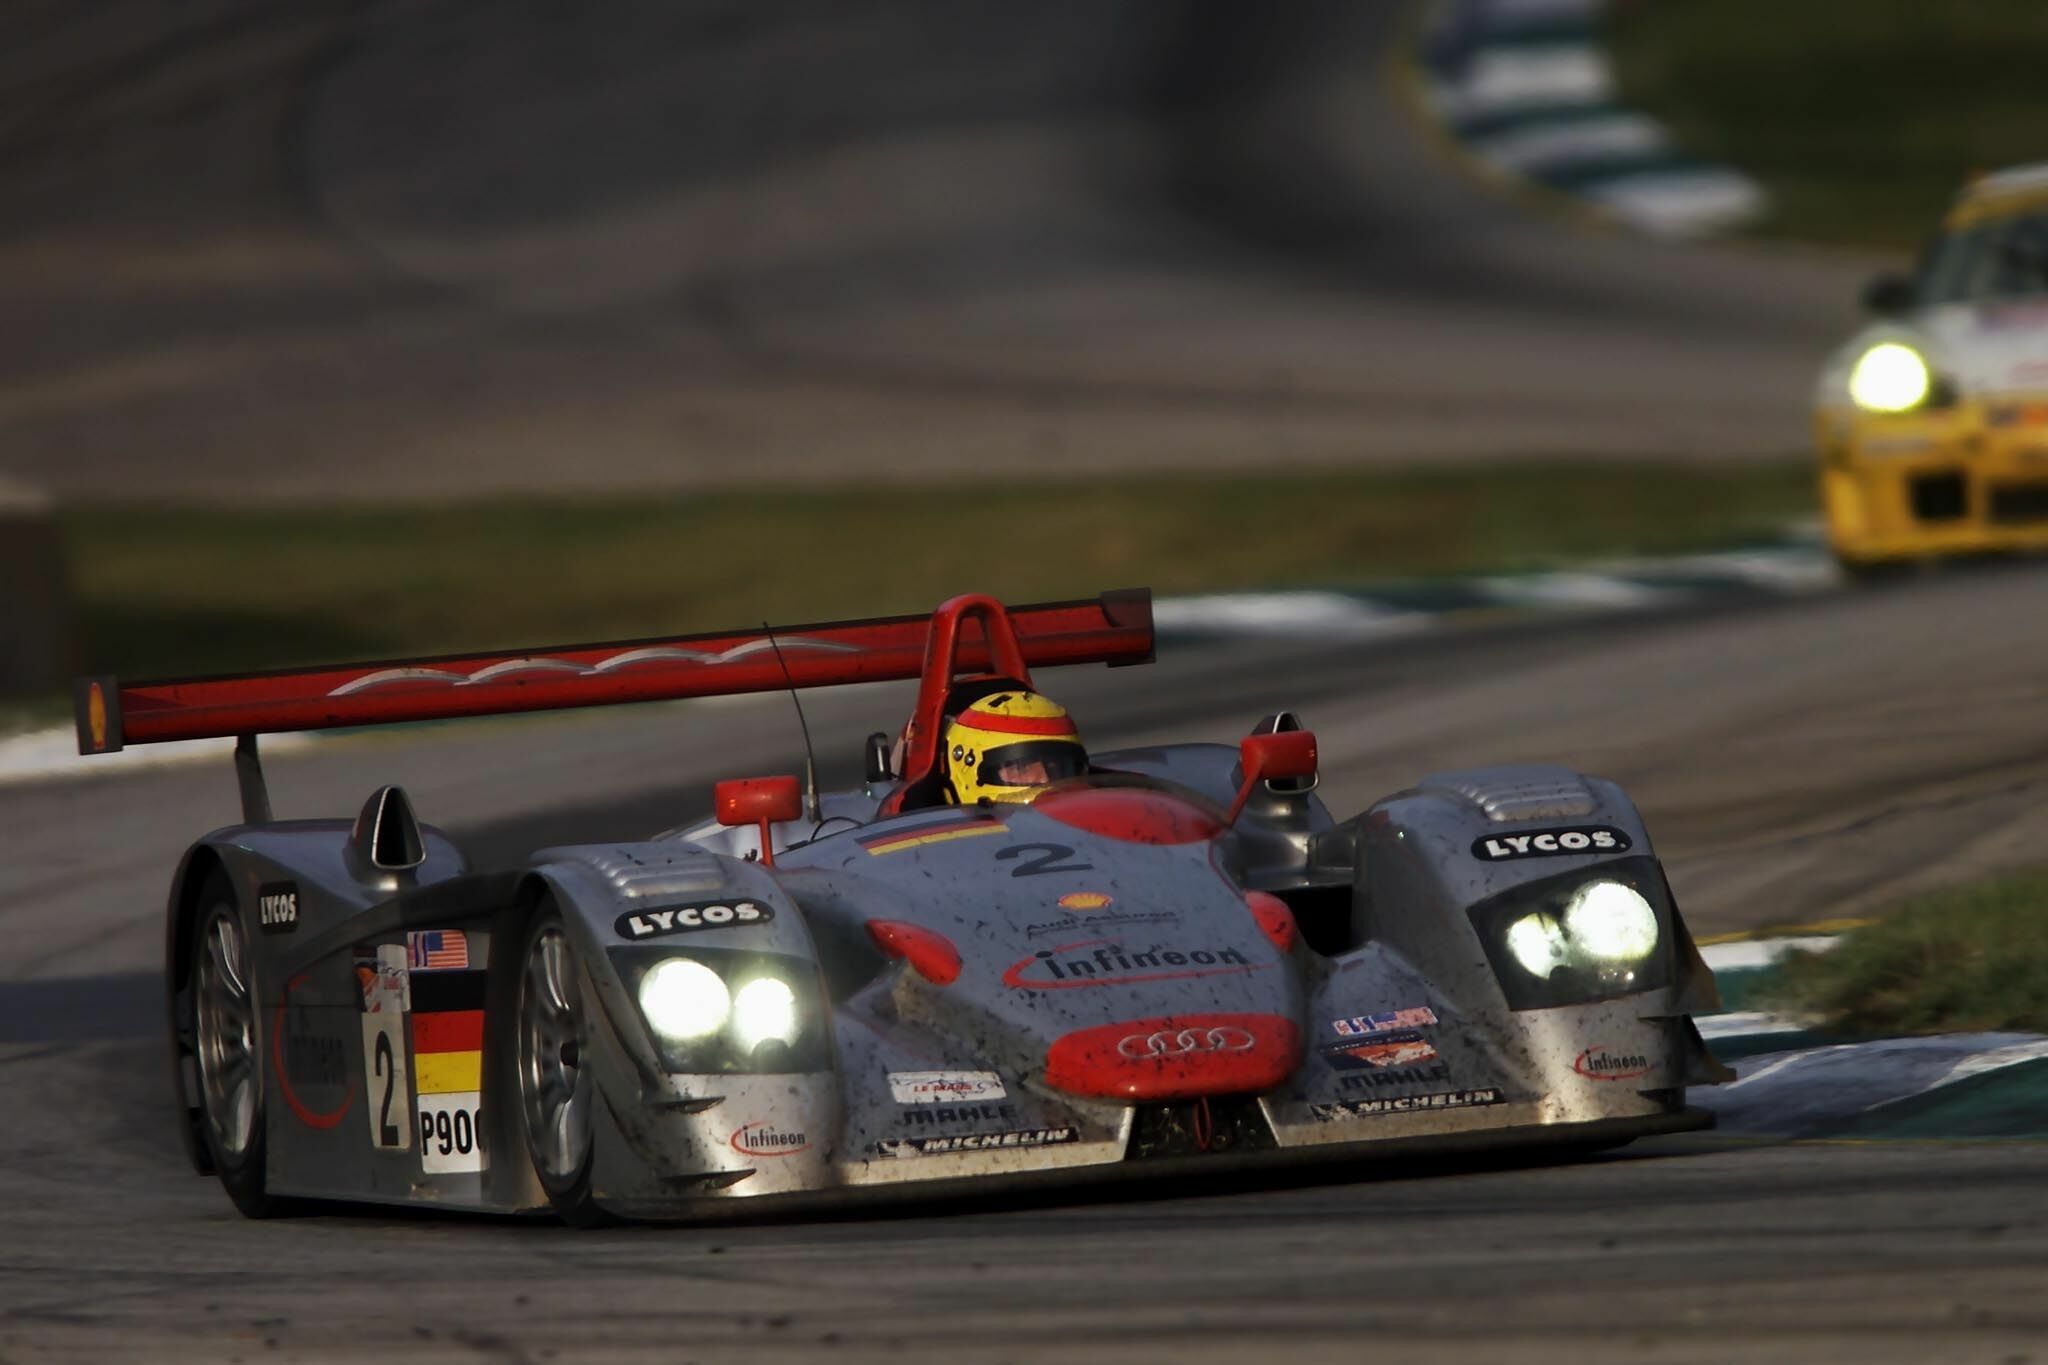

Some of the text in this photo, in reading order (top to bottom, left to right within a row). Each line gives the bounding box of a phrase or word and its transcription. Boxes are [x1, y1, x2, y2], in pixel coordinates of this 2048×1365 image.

[1485, 830, 1617, 858] LYCOS
[995, 842, 1094, 878] 2
[260, 893, 296, 925] LYCOS
[629, 902, 760, 936] LYCOS
[375, 1030, 399, 1146] 2
[1357, 1090, 1496, 1113] MICHELIN
[903, 1104, 1017, 1125] MAHLE
[923, 1127, 1070, 1151] MICHELIN
